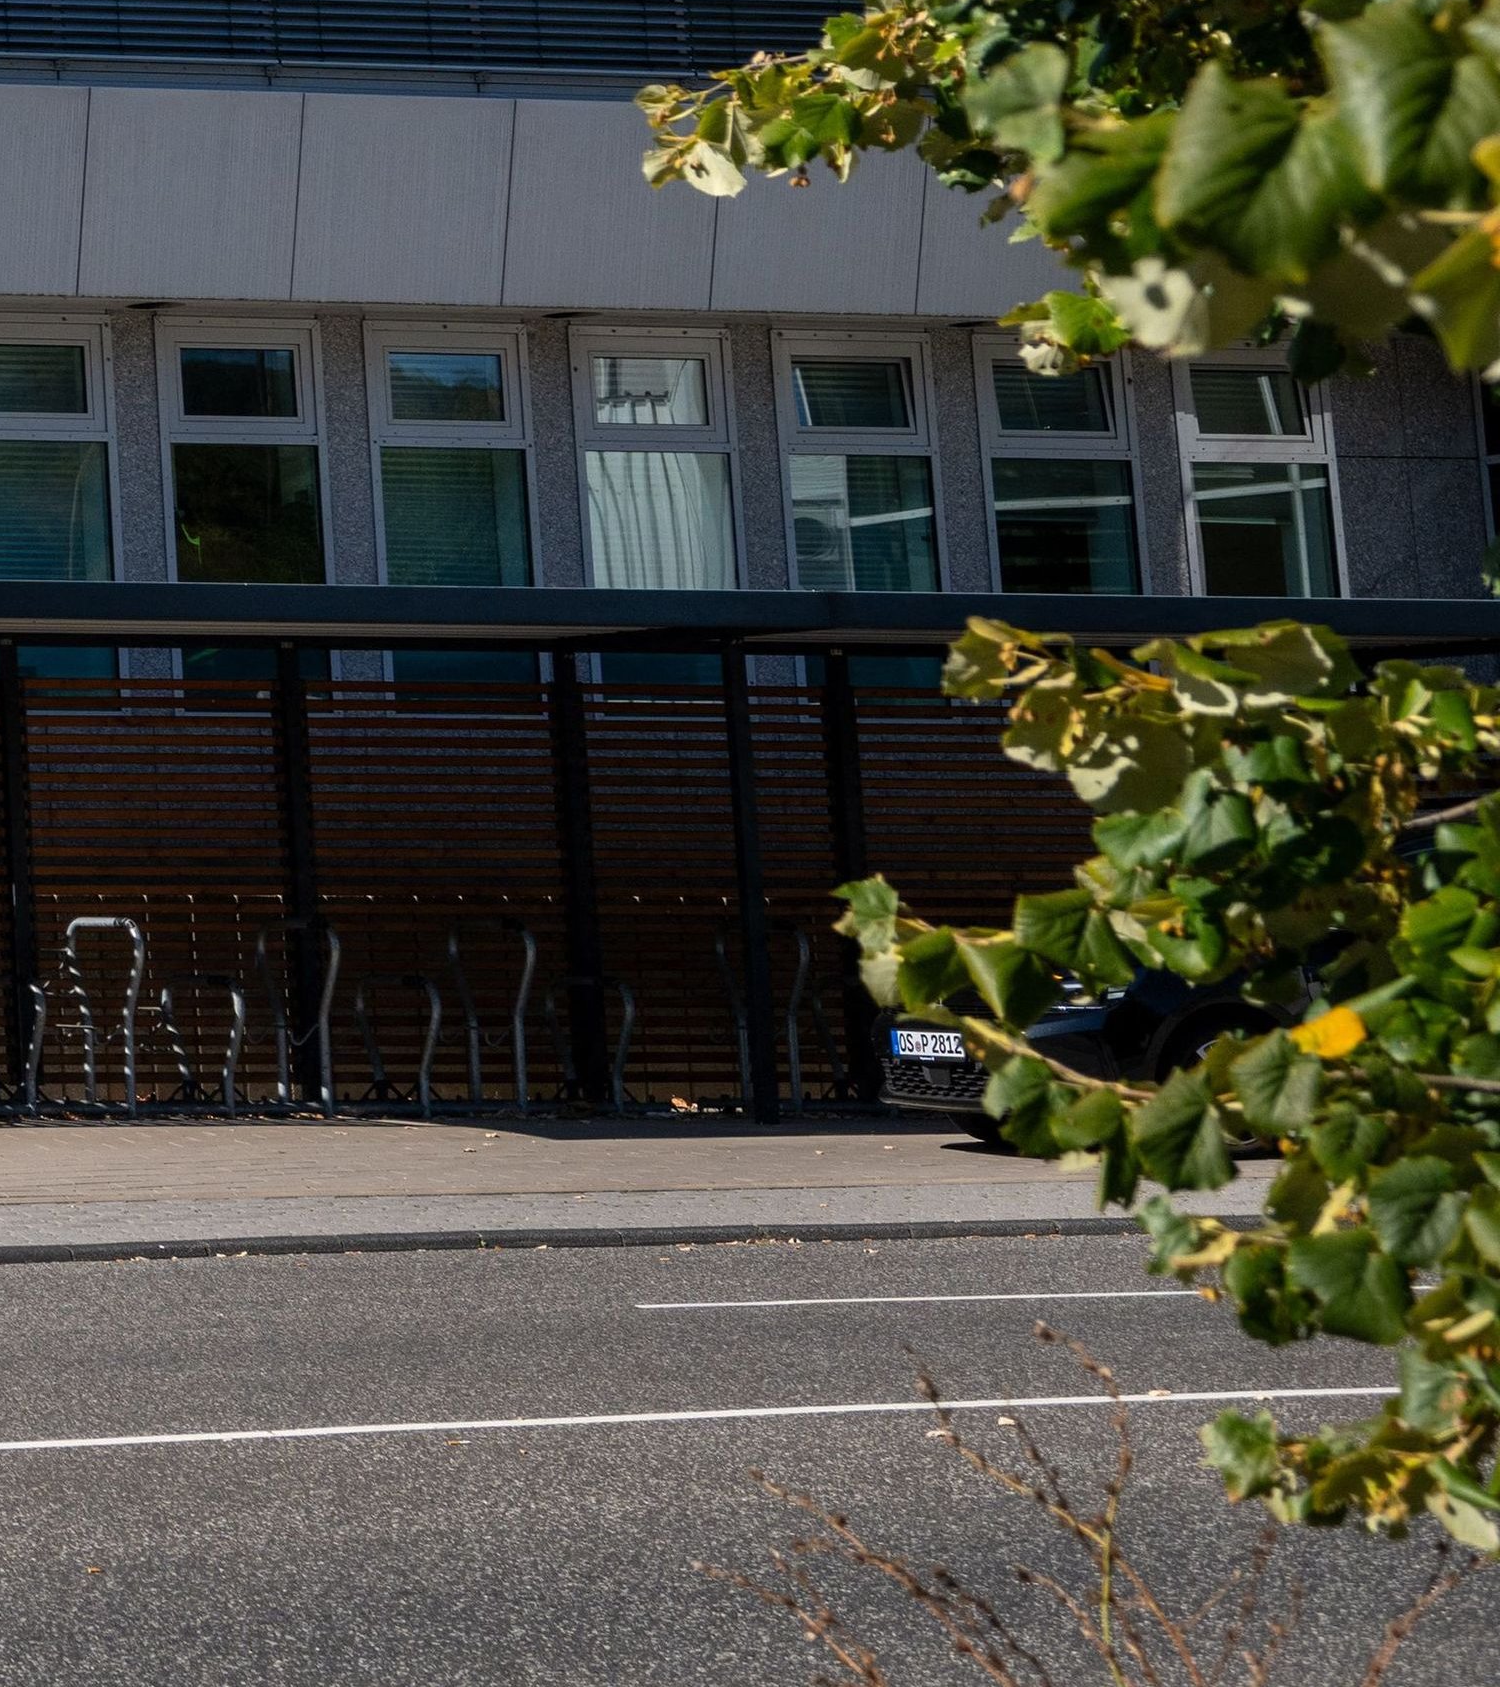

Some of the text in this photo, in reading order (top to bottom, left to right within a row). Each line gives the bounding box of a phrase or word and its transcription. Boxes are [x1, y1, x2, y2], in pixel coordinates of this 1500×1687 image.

[900, 1034, 962, 1054] OS P 2812
